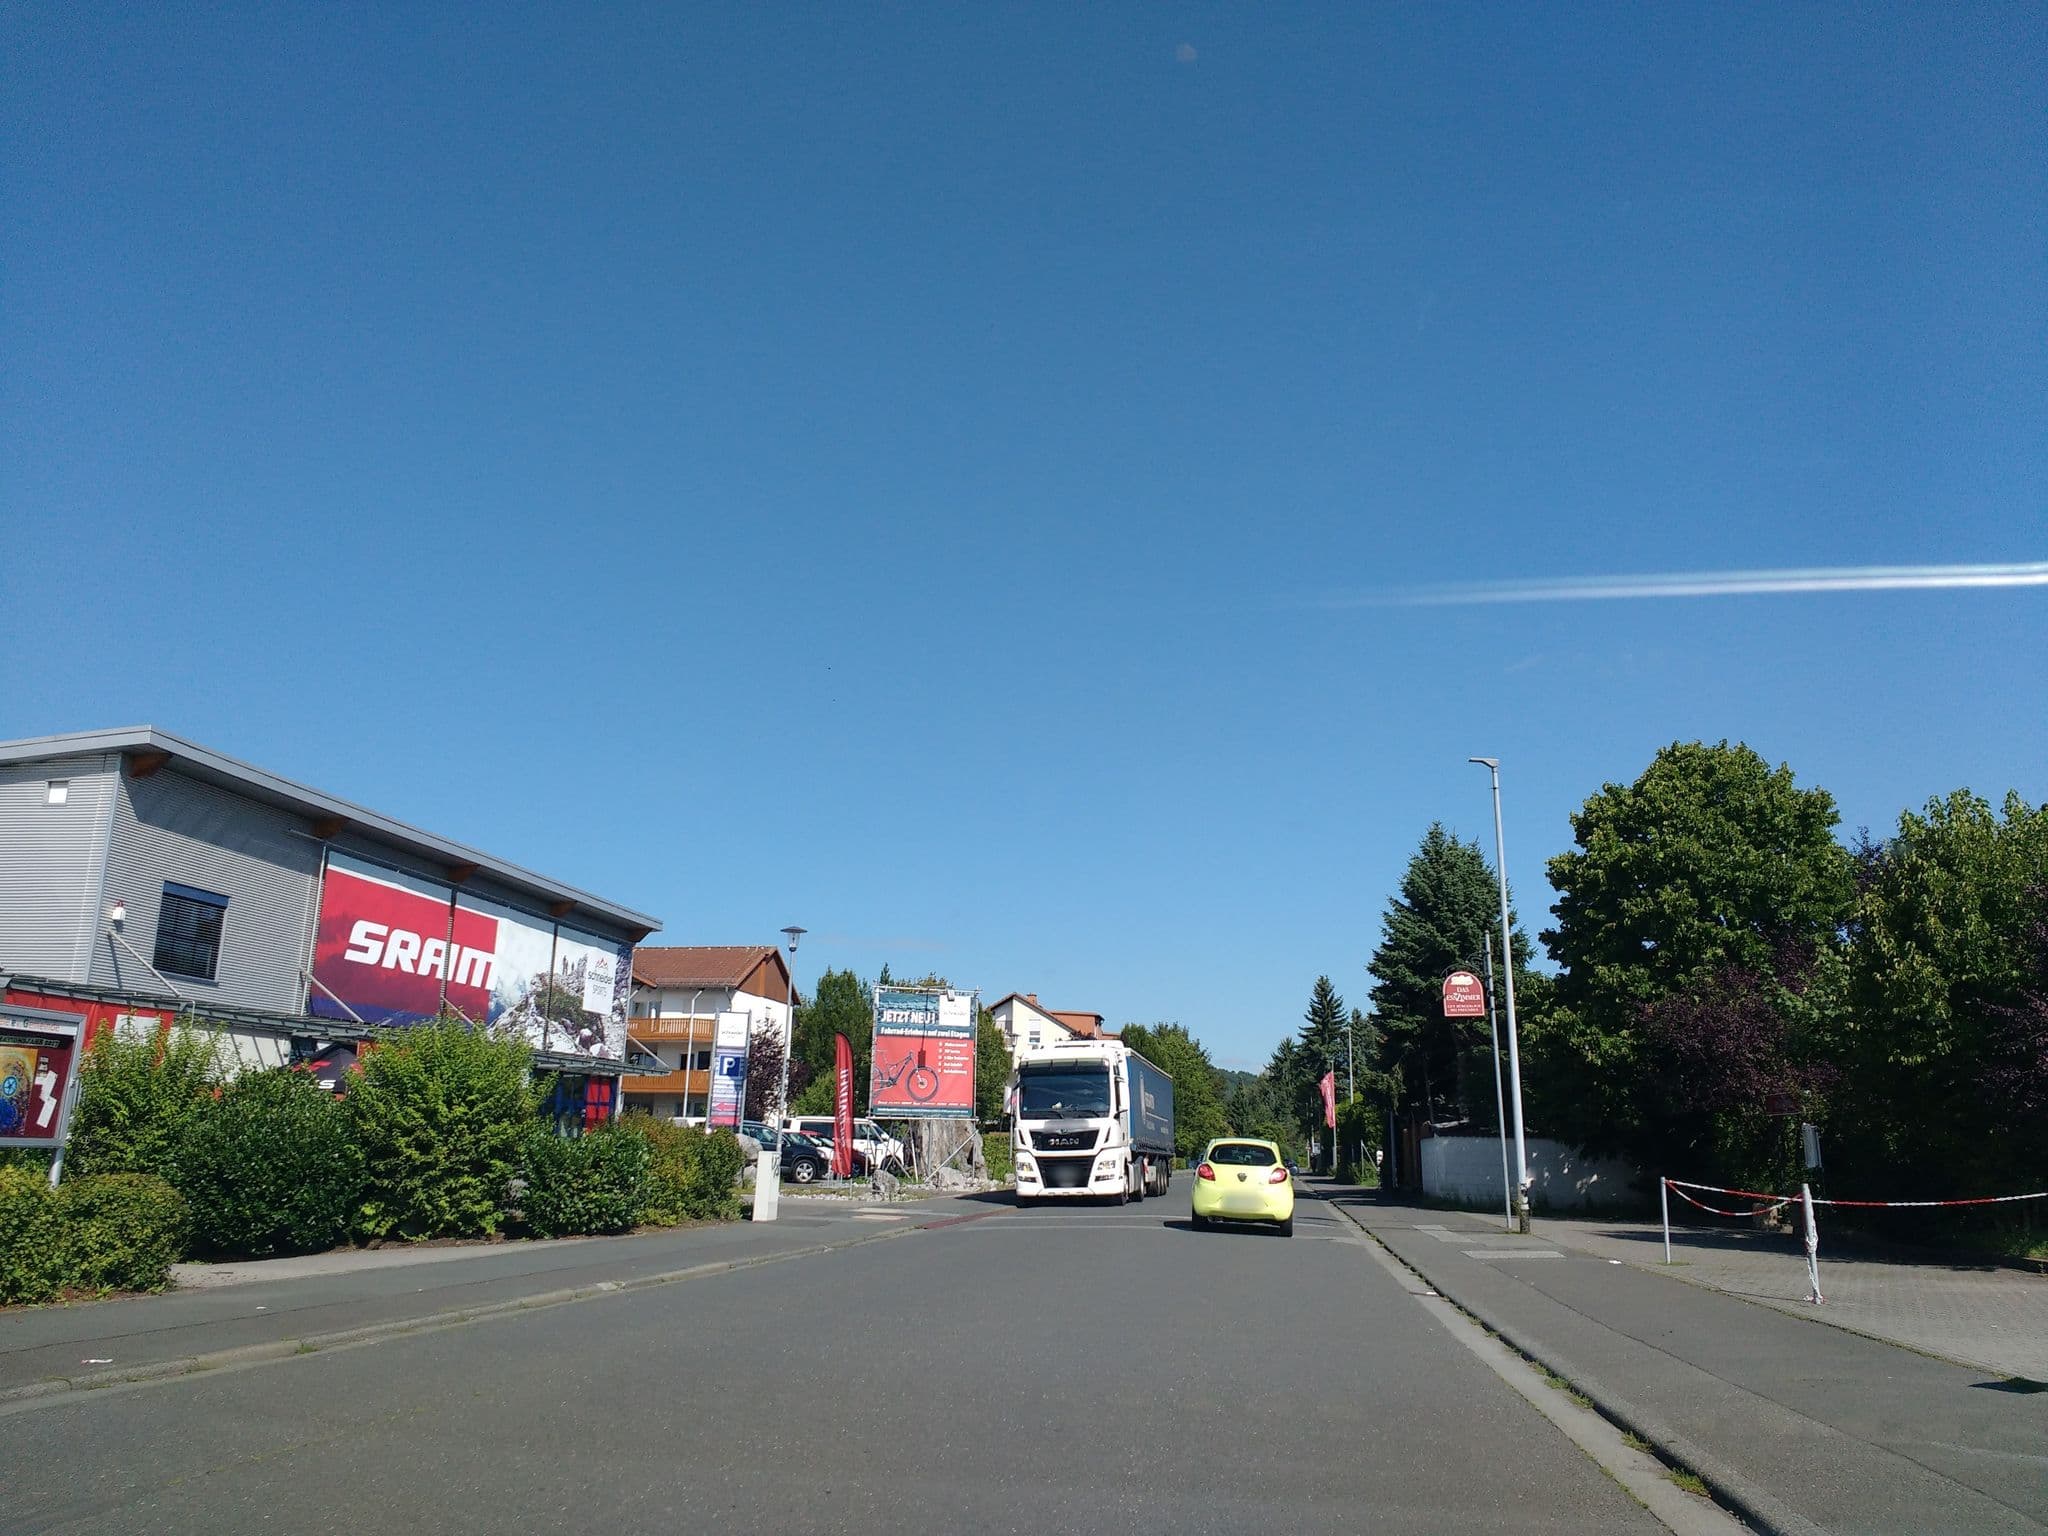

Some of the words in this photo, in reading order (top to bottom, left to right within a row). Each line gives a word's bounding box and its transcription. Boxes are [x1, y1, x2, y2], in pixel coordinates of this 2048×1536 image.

[344, 920, 498, 991] SRAM
[880, 1009, 909, 1023] JETZT
[910, 1011, 936, 1025] NEU!
[722, 1057, 736, 1075] P
[1048, 1137, 1080, 1146] MAN
